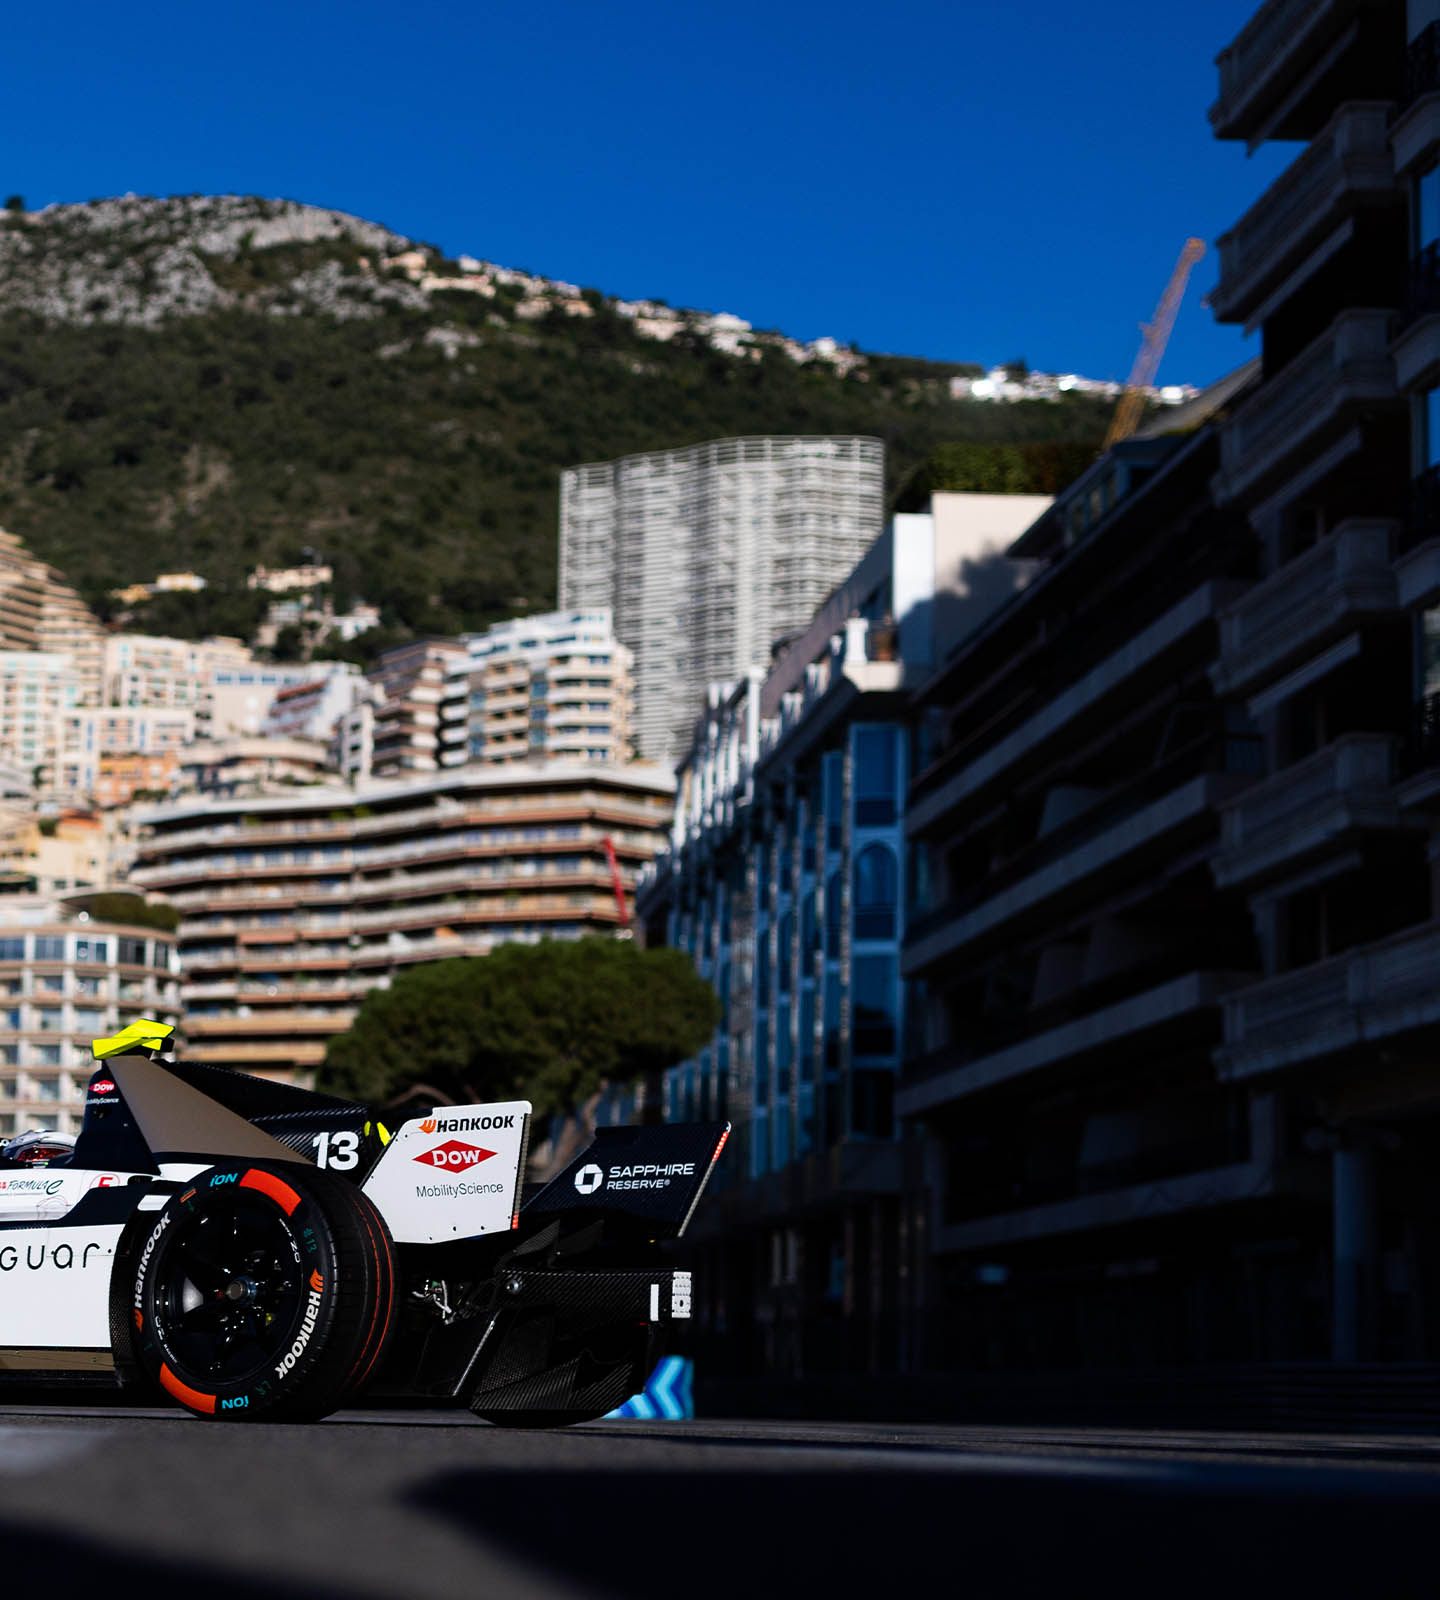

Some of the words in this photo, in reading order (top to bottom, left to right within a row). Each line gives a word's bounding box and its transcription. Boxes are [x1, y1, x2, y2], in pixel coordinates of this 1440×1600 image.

[312, 1131, 359, 1170] 13
[608, 1163, 696, 1178] SAPPHIRE
[7, 1180, 50, 1190] FORMULA
[416, 1182, 504, 1199] MobilityScience
